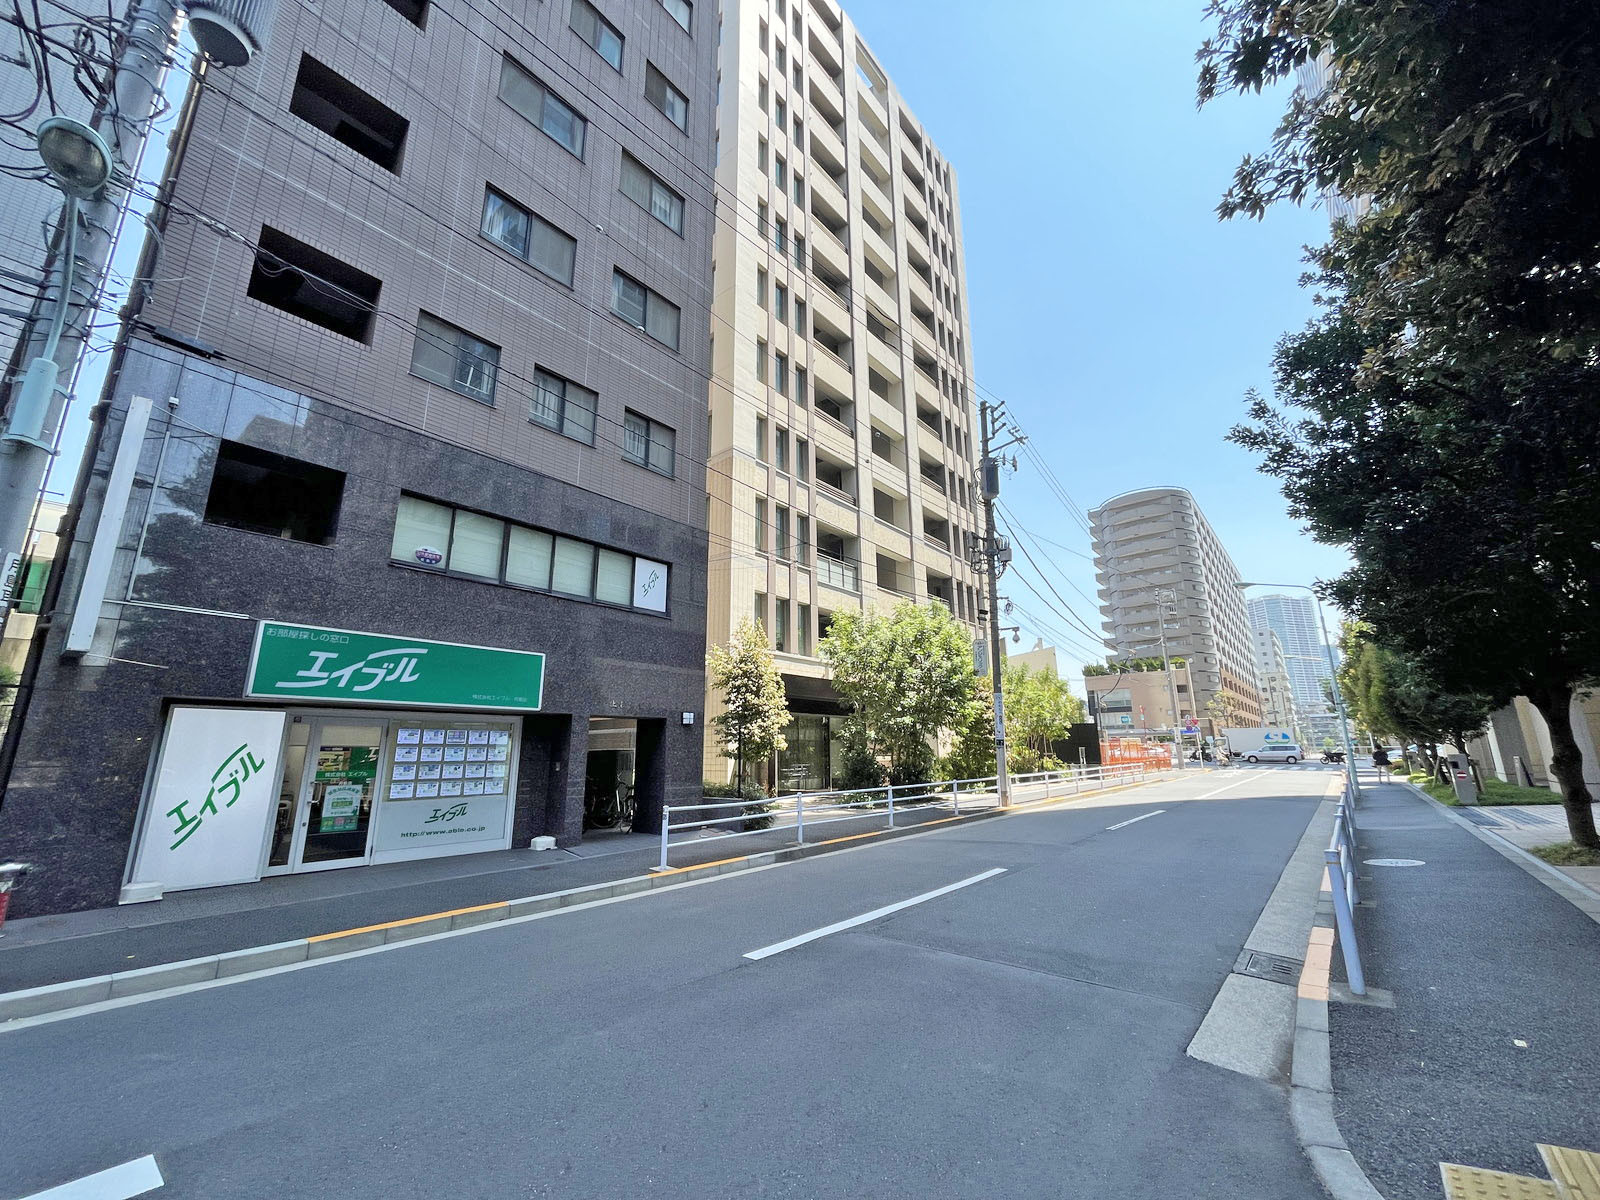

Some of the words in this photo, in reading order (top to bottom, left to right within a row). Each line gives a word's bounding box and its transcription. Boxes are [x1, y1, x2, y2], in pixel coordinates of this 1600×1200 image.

[266, 627, 349, 644] お部屋探しの窓口
[274, 647, 429, 692] エイブル
[166, 742, 266, 851] エイブル
[424, 802, 469, 824] エイブル
